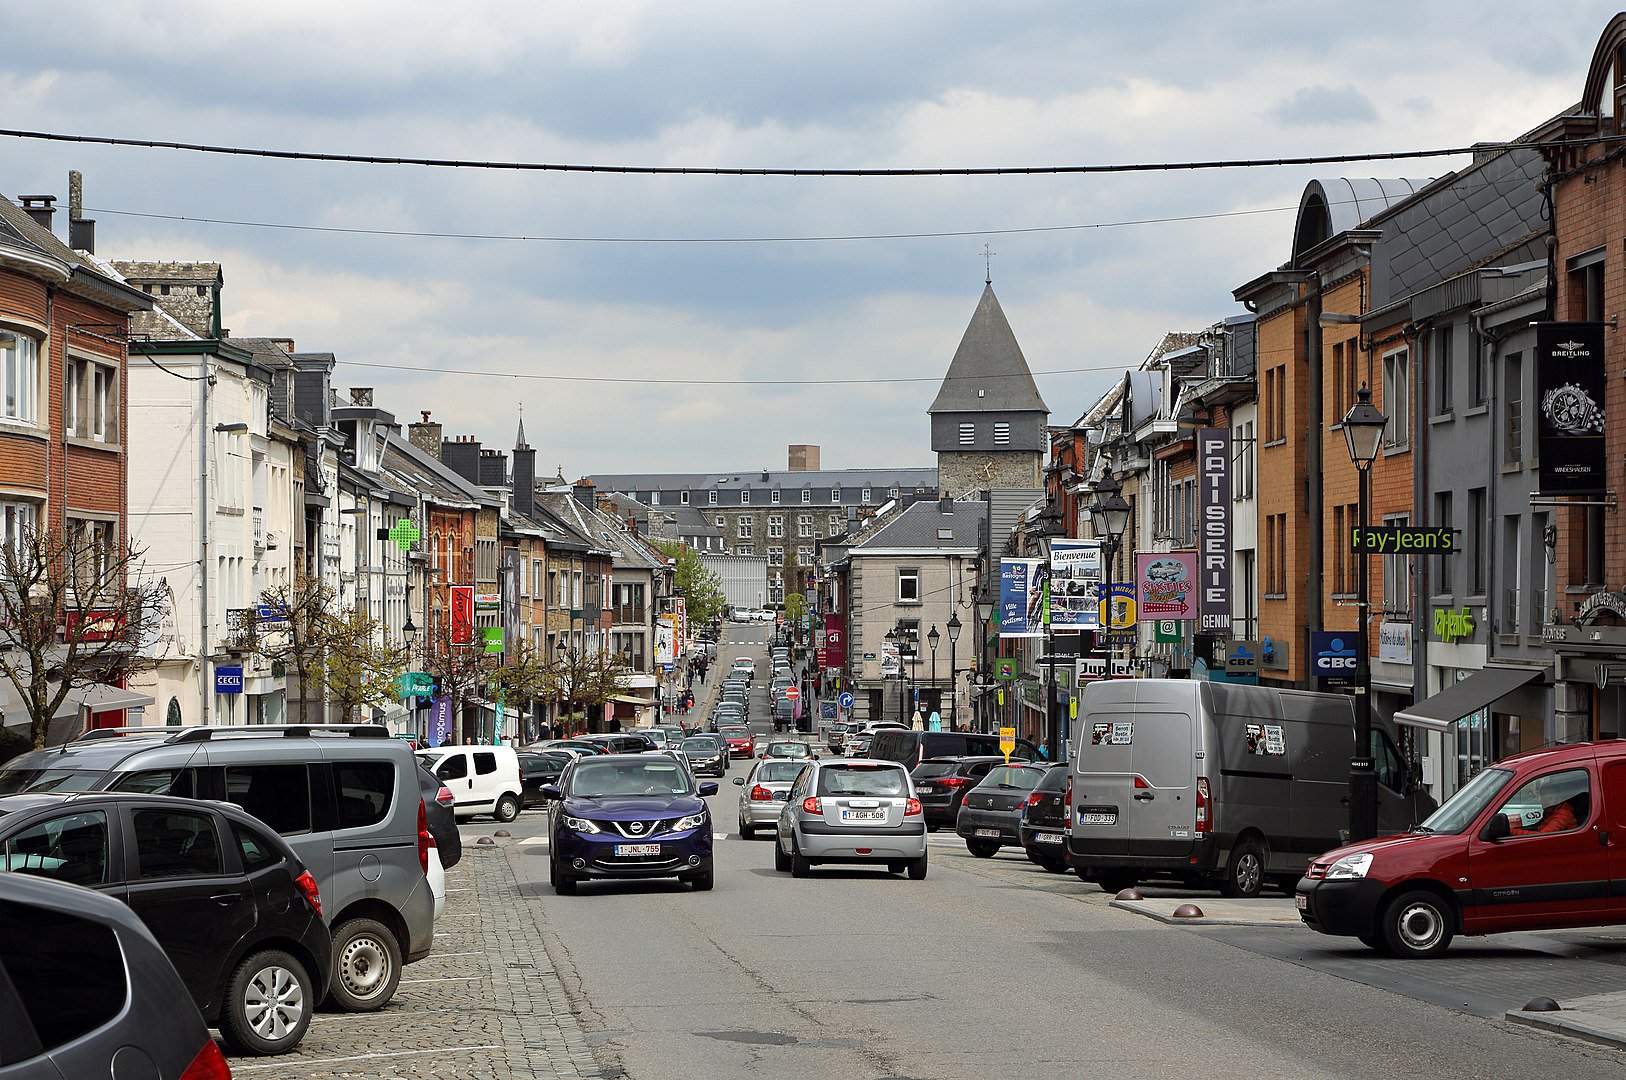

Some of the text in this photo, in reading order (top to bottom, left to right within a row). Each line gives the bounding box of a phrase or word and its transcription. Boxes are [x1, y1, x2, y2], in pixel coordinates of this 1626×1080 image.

[1205, 440, 1226, 603] PATISSERIE
[1352, 528, 1451, 553] Ray-Jean's
[1053, 551, 1096, 561] Bienvenue
[1142, 580, 1193, 593] SIXTIES
[1202, 614, 1230, 628] GENIN
[829, 633, 839, 643] di
[1081, 662, 1134, 676] Jupler
[1317, 657, 1357, 669] CBC
[620, 845, 660, 854] 1-JNL-755
